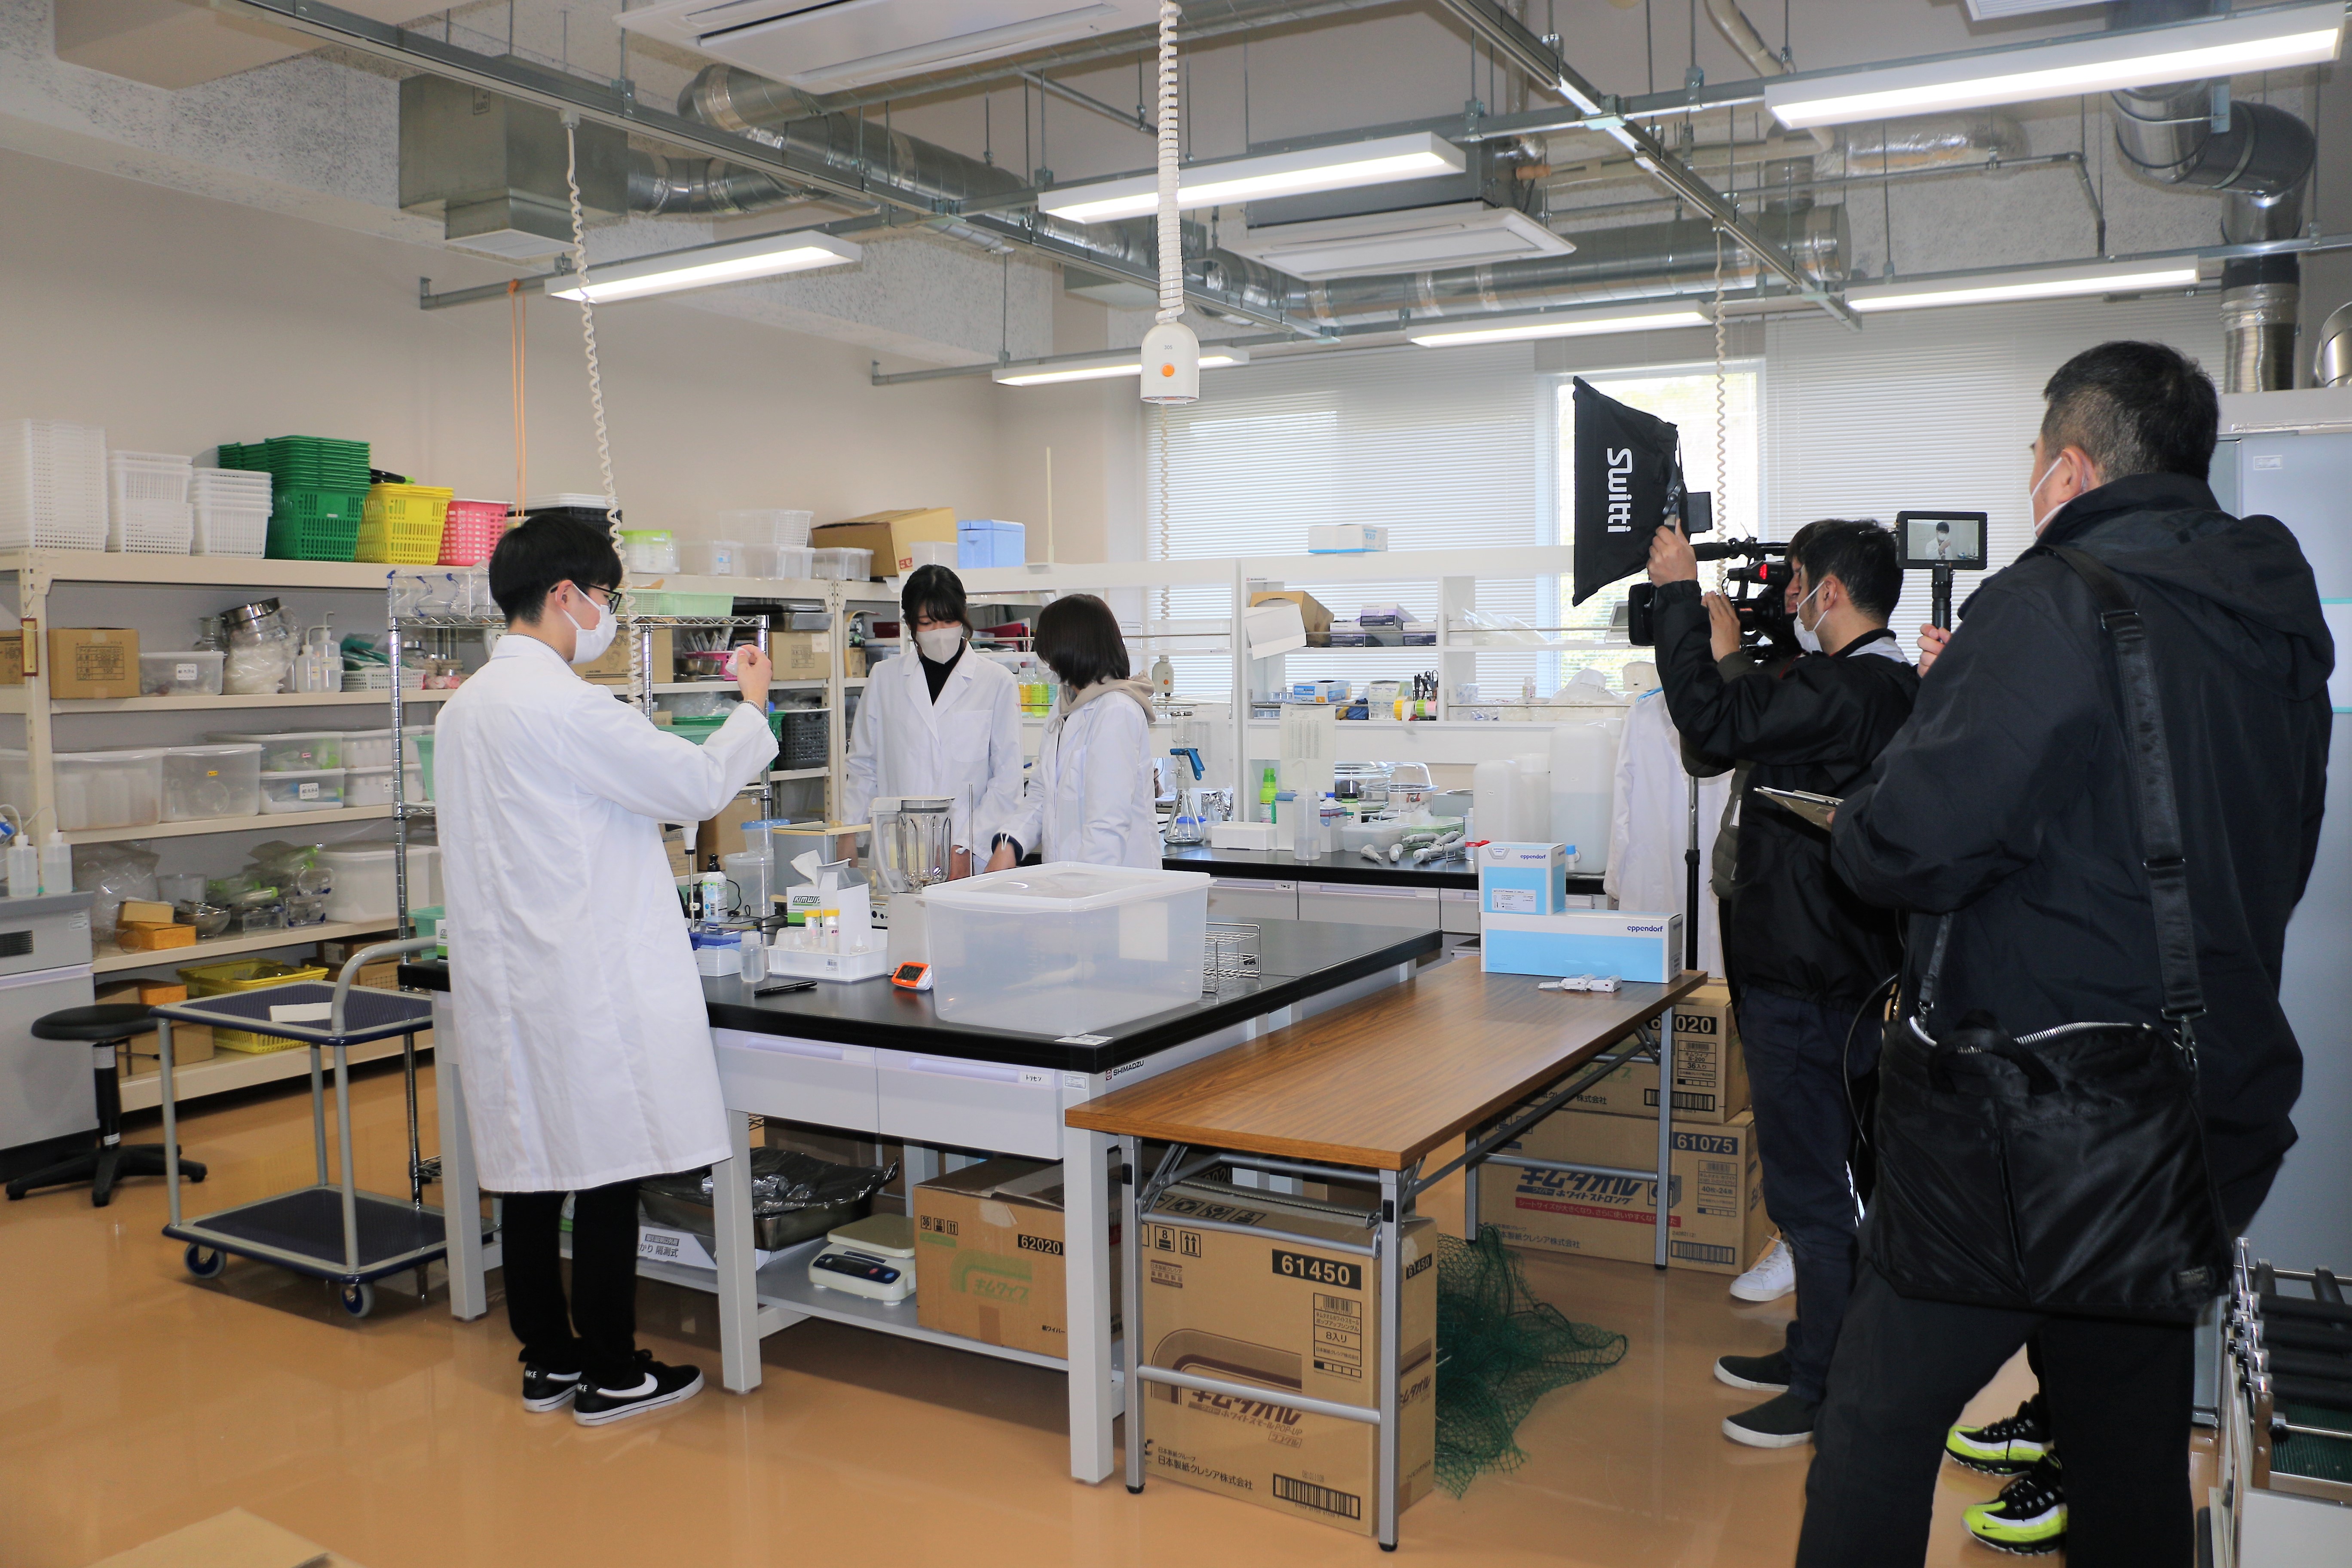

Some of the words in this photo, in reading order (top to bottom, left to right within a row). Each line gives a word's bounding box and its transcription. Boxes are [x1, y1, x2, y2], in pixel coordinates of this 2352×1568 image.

[1607, 448, 1632, 533] Switti
[1651, 1015, 1712, 1033] 6020
[1113, 1060, 1144, 1076] SHIMADZU
[1677, 1134, 1733, 1153] 61075
[1162, 1230, 1168, 1239] 8
[1021, 1236, 1060, 1254] 62020
[1282, 1255, 1350, 1285] 61450
[1409, 1257, 1429, 1277] 61450
[1326, 1332, 1347, 1343] 8入り
[1275, 1423, 1302, 1436] POP-UP
[1158, 1455, 1253, 1490] 日本製紙クレシア株式会社
